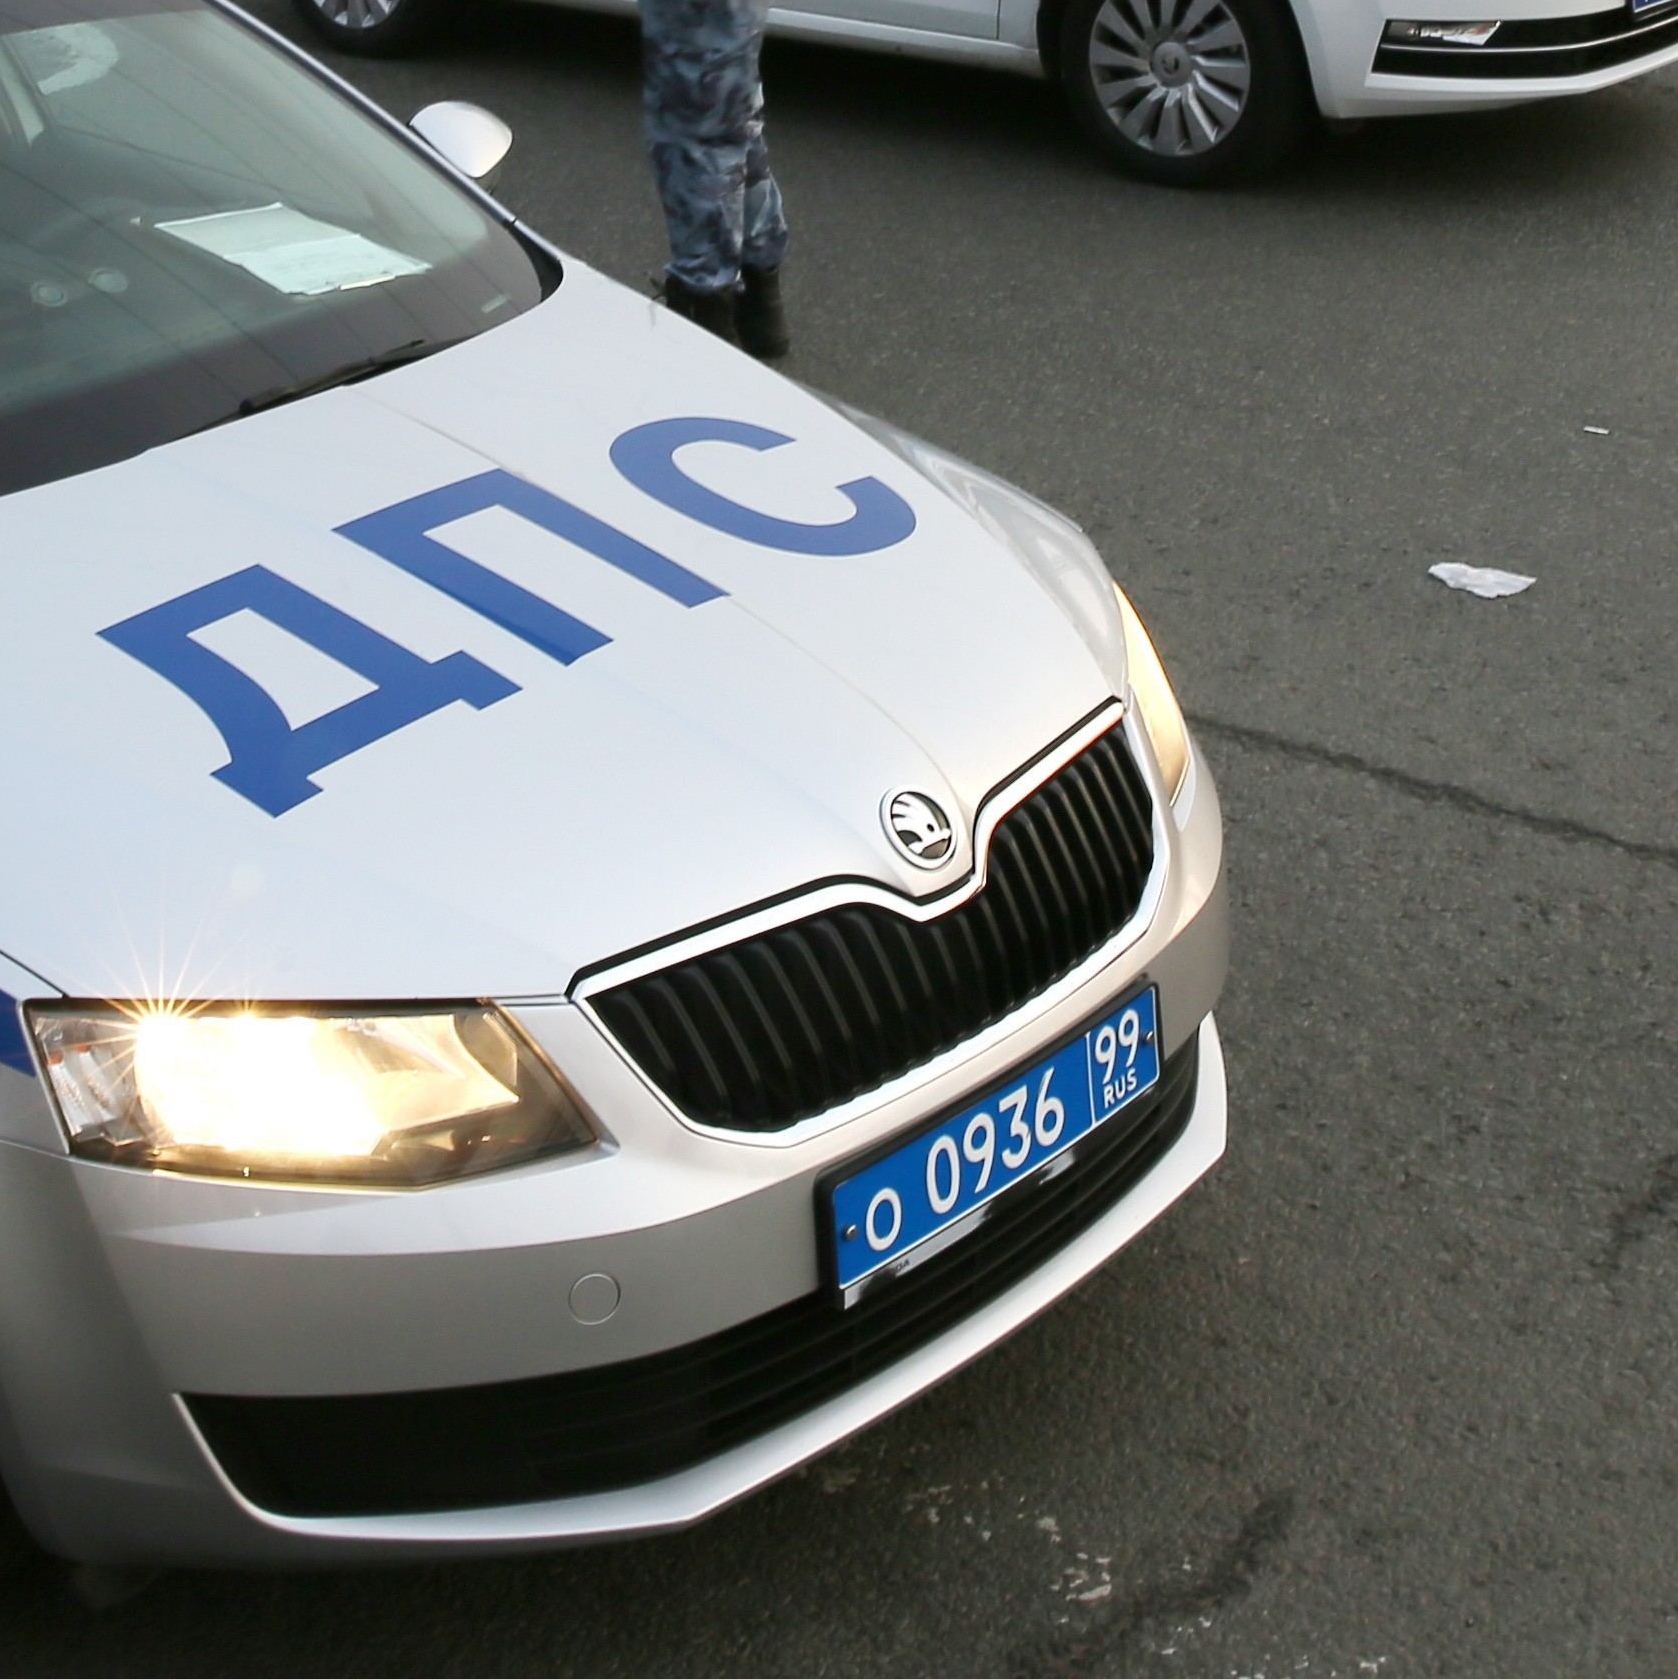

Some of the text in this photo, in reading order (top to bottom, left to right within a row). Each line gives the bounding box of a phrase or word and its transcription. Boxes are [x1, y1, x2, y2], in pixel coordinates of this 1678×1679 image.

[96, 416, 918, 820] ДПС
[1094, 1008, 1140, 1086] 99
[1103, 1067, 1138, 1110] RUS
[865, 1066, 1065, 1252] О 0936
